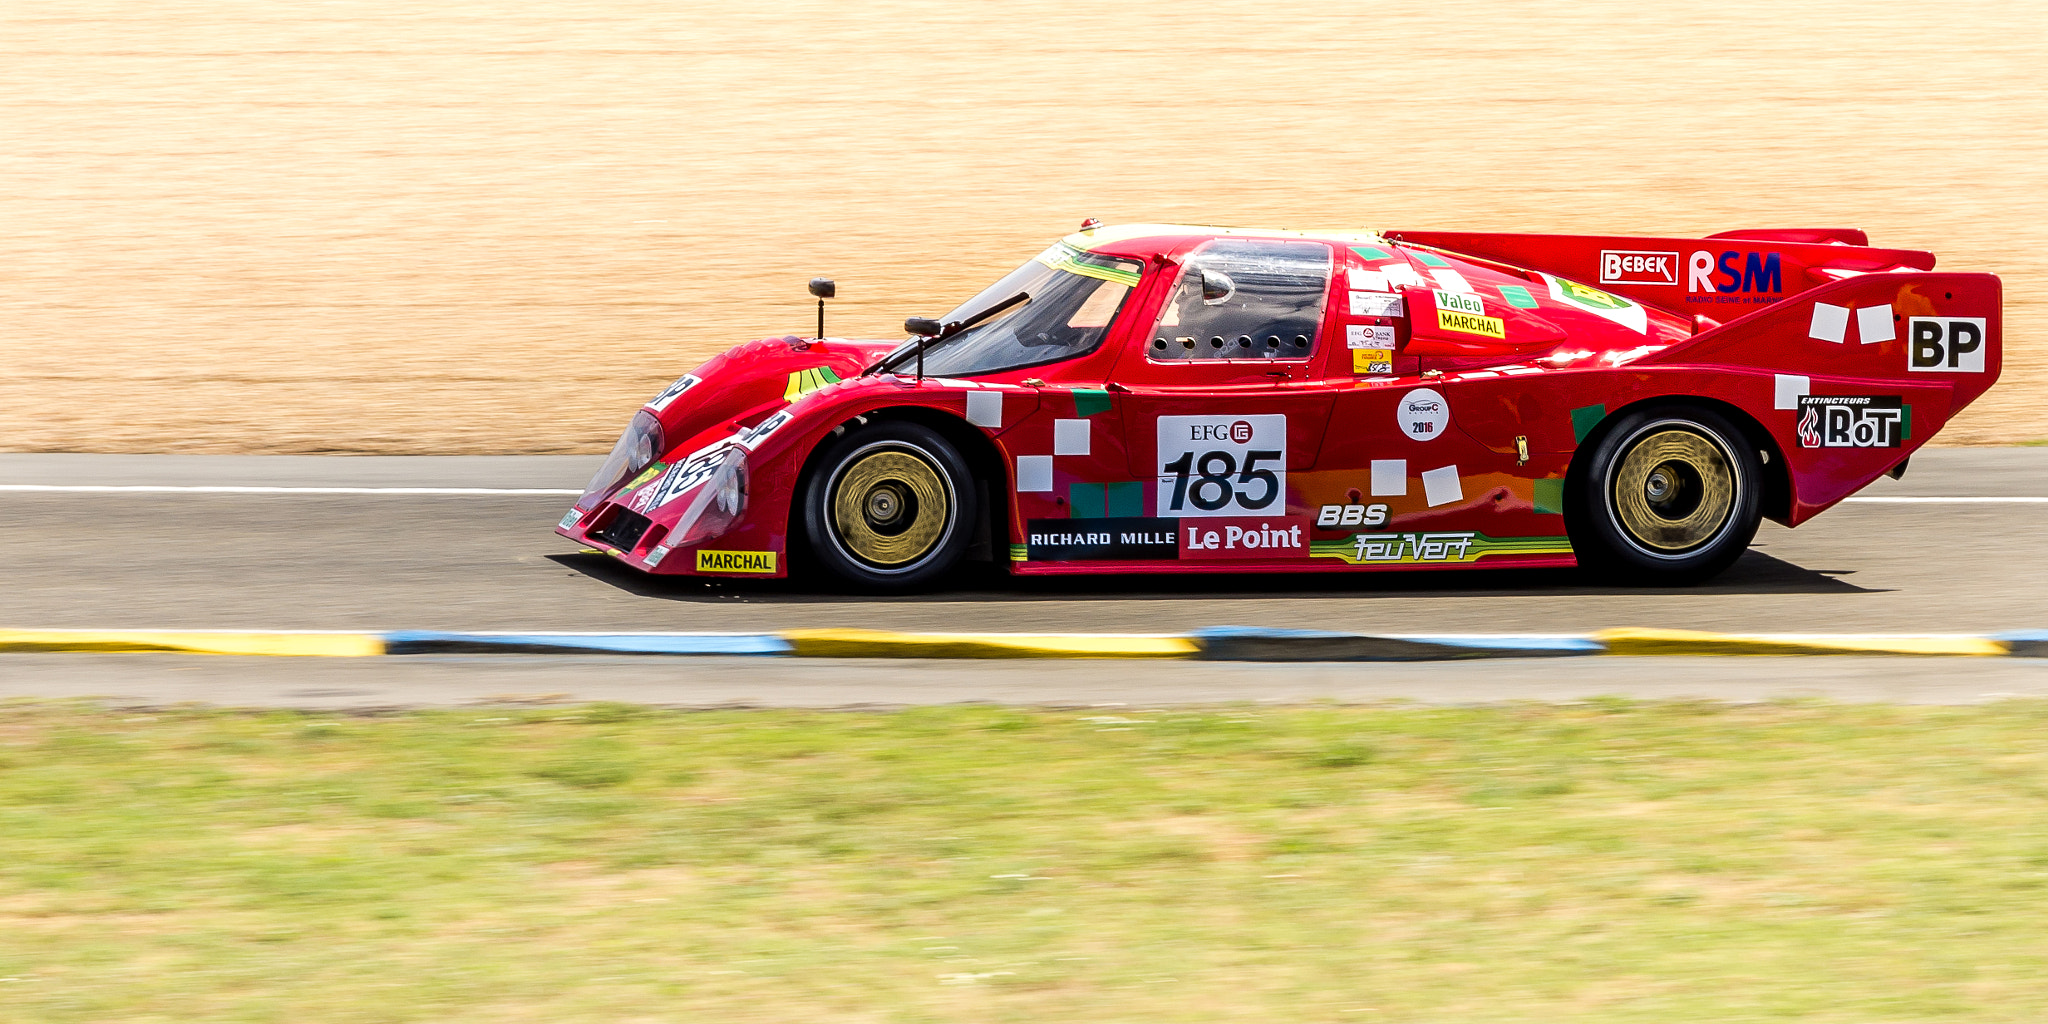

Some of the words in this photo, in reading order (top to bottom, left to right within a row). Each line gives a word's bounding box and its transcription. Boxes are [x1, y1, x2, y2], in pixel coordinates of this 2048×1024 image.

[1605, 256, 1673, 281] BEBEK
[1688, 250, 1782, 293] RSM
[1437, 290, 1482, 312] Valeo
[1715, 296, 1740, 304] SEINE
[1442, 313, 1500, 334] MARCHAL
[1911, 321, 1981, 368] BP
[1801, 397, 1871, 405] EXTINCTEURS
[1190, 425, 1228, 440] EFG
[1412, 422, 1433, 433] 2016
[1163, 450, 1282, 511] 185
[1317, 504, 1388, 527] BBS
[1030, 532, 1111, 546] RICHARD
[1120, 532, 1175, 545] MILLE
[1187, 526, 1220, 550] Le
[1224, 523, 1302, 549] Point
[700, 555, 771, 570] MARCHAL
